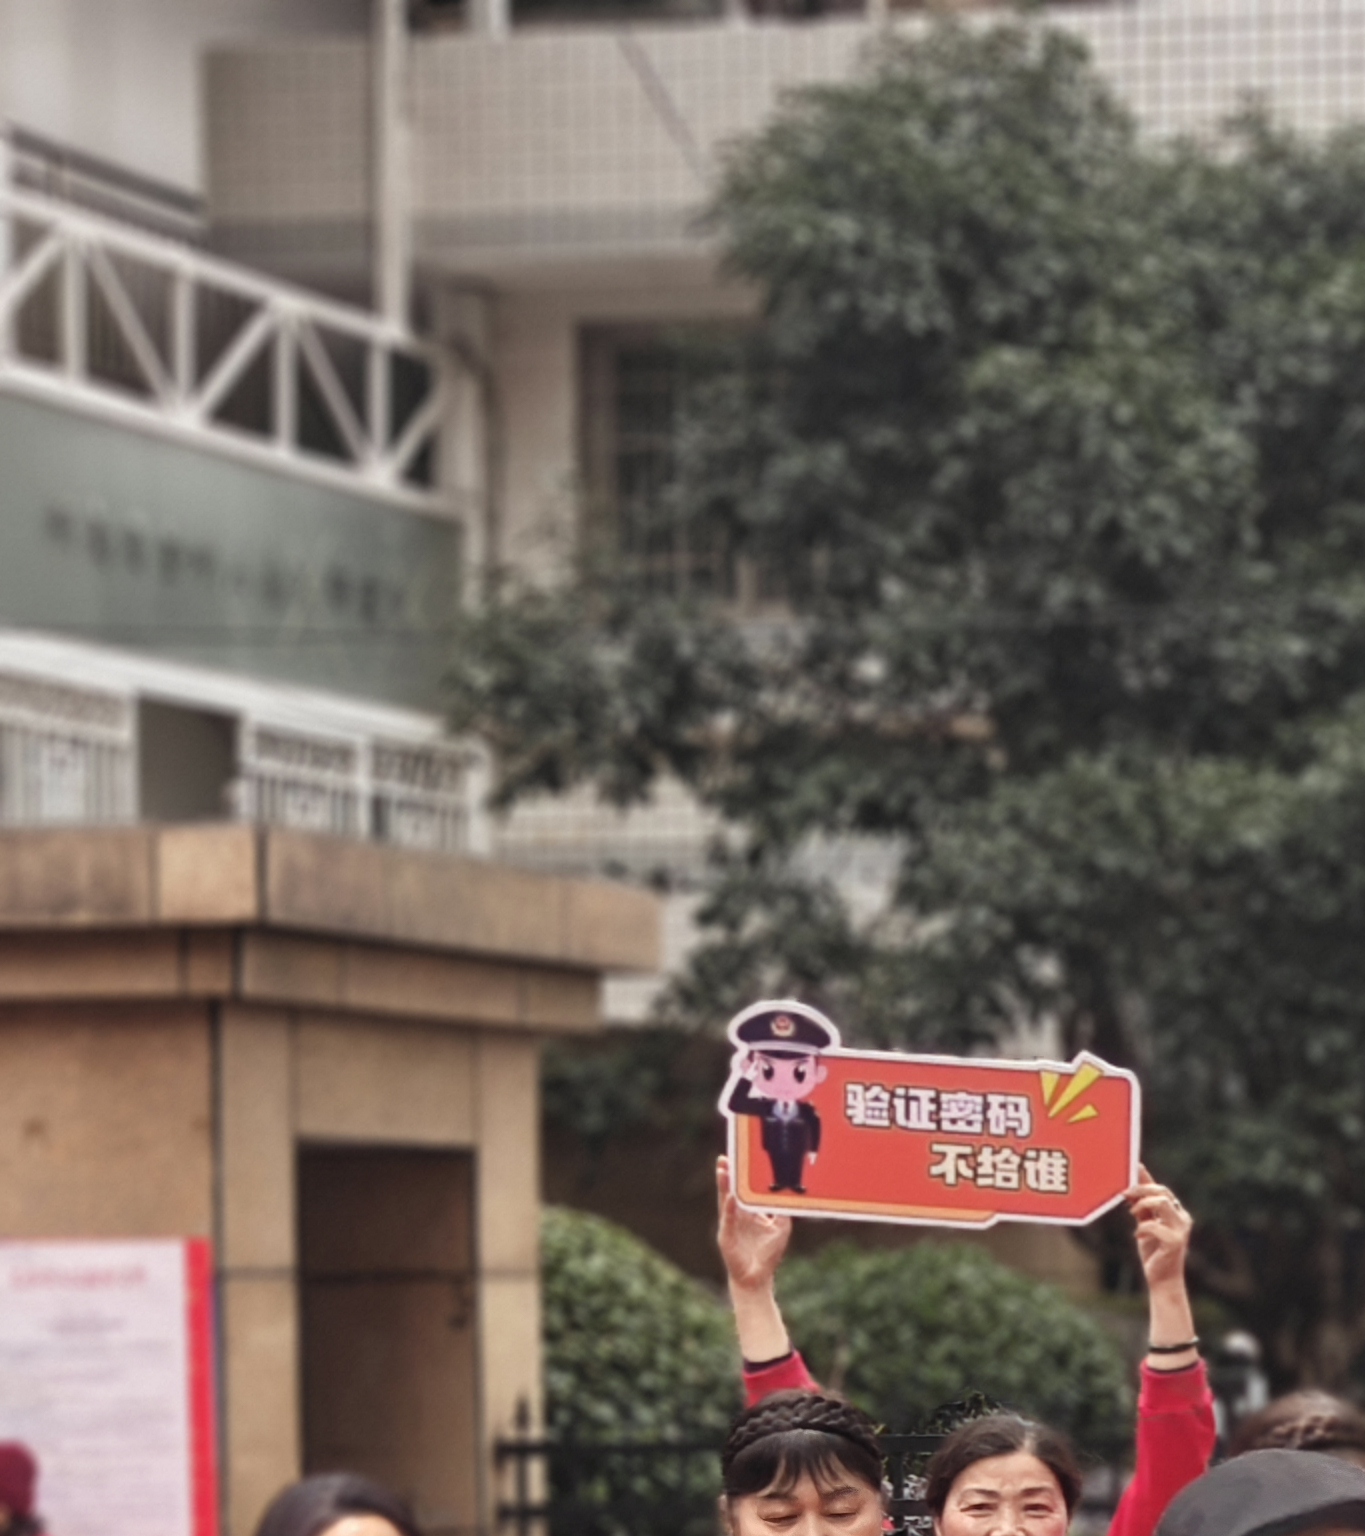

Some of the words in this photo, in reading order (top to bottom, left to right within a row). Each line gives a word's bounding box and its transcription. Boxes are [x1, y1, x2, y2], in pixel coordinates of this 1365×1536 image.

[845, 1083, 1031, 1138] 验证密码
[930, 1143, 1069, 1193] 不给谁
